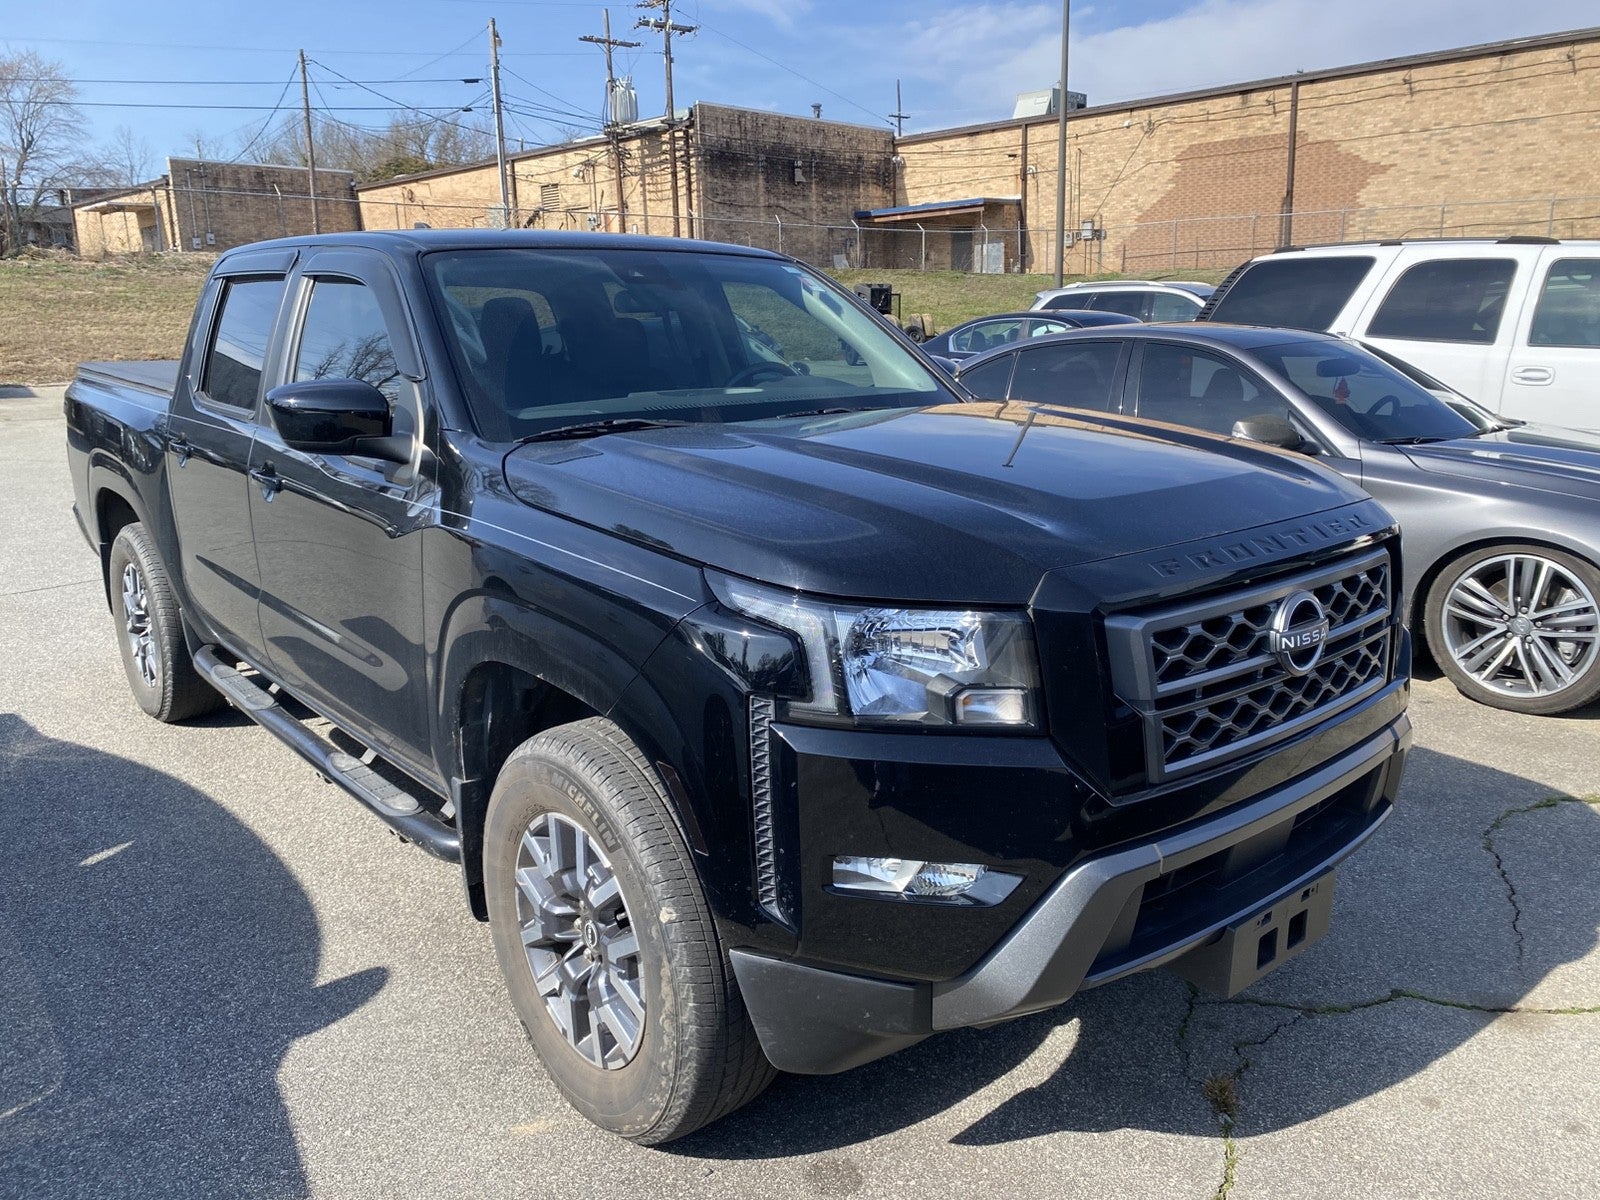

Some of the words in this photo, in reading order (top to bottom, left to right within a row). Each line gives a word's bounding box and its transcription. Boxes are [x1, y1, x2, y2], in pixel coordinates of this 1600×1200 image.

[1148, 513, 1372, 578] FRONTIER
[1281, 624, 1328, 649] NISSA
[551, 772, 617, 848] MICHELIN
